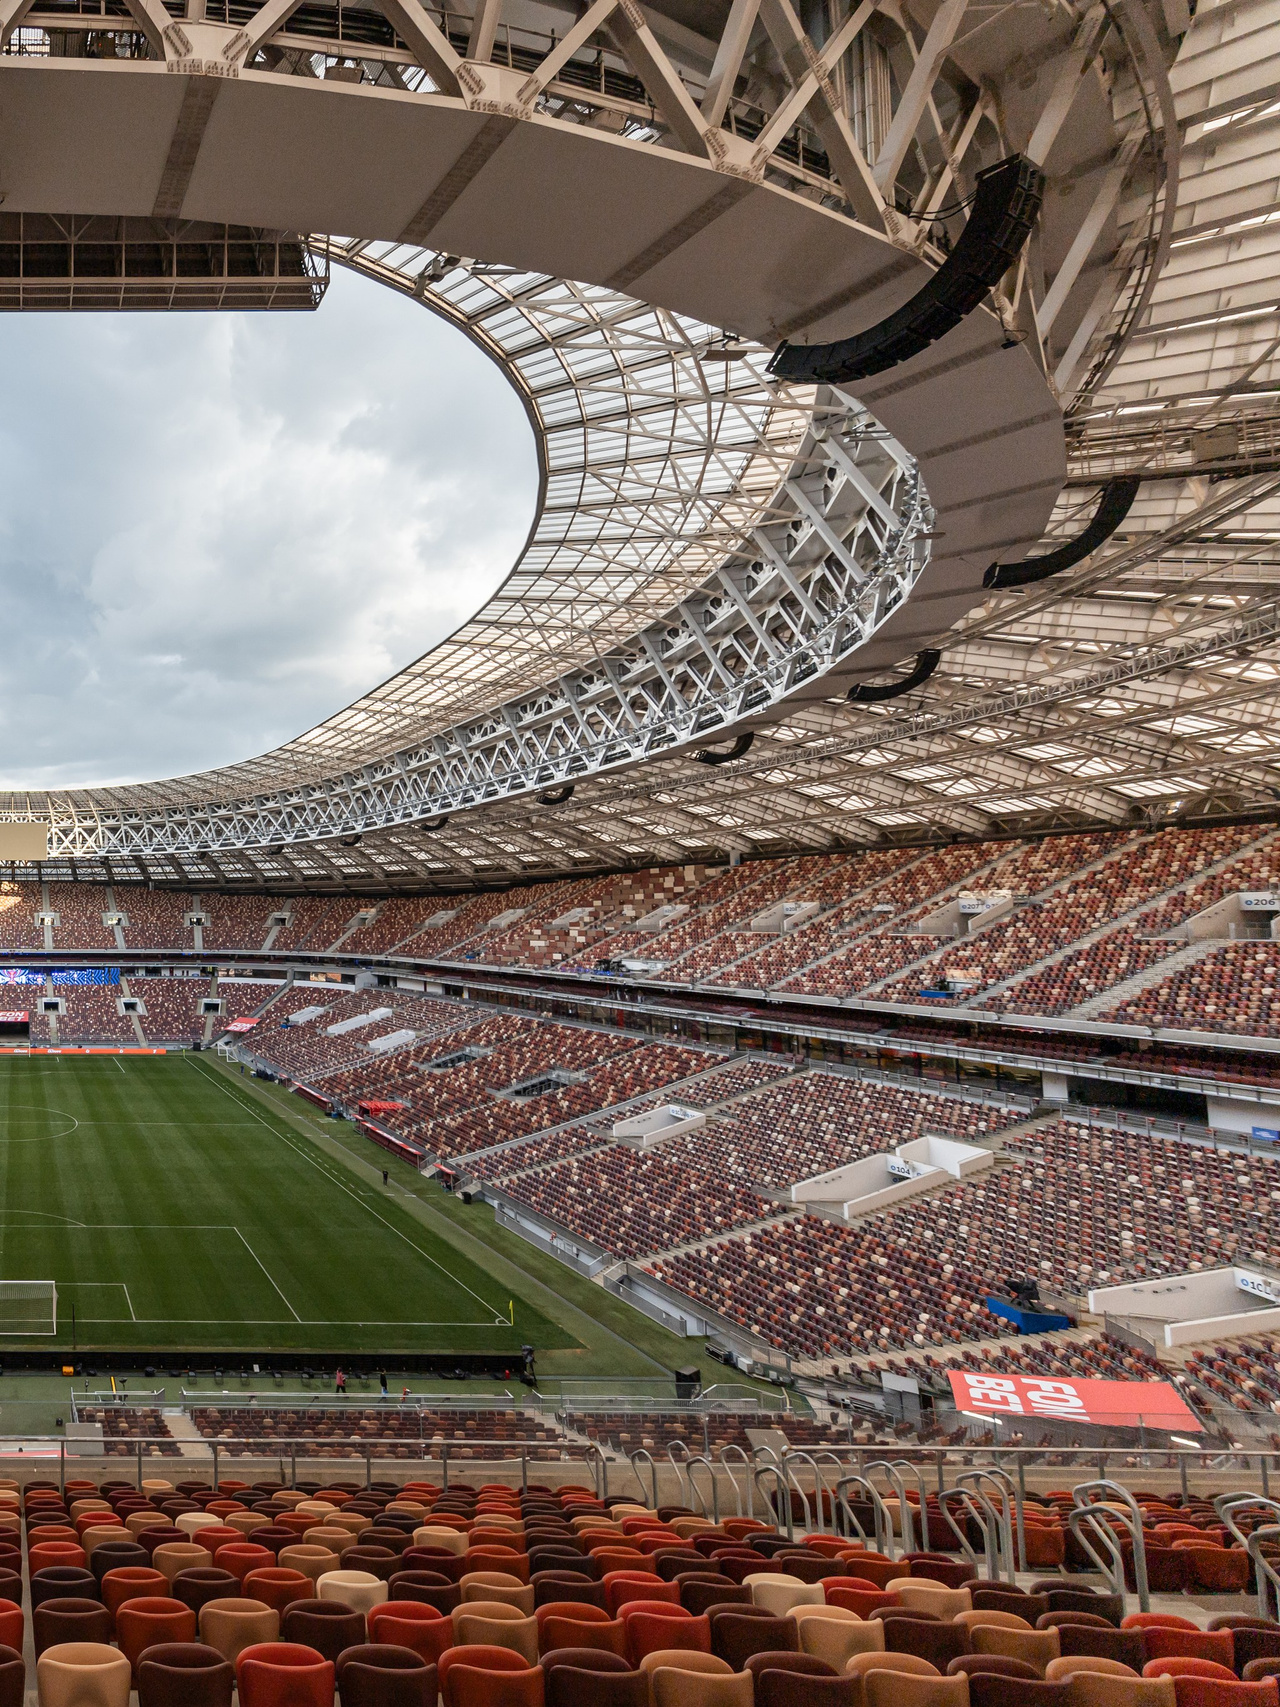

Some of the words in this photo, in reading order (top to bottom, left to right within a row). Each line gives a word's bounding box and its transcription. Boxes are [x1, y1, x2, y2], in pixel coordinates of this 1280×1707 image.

[896, 1166, 911, 1175] 104
[963, 1373, 1025, 1415] BET
[1020, 1377, 1091, 1421] FON
